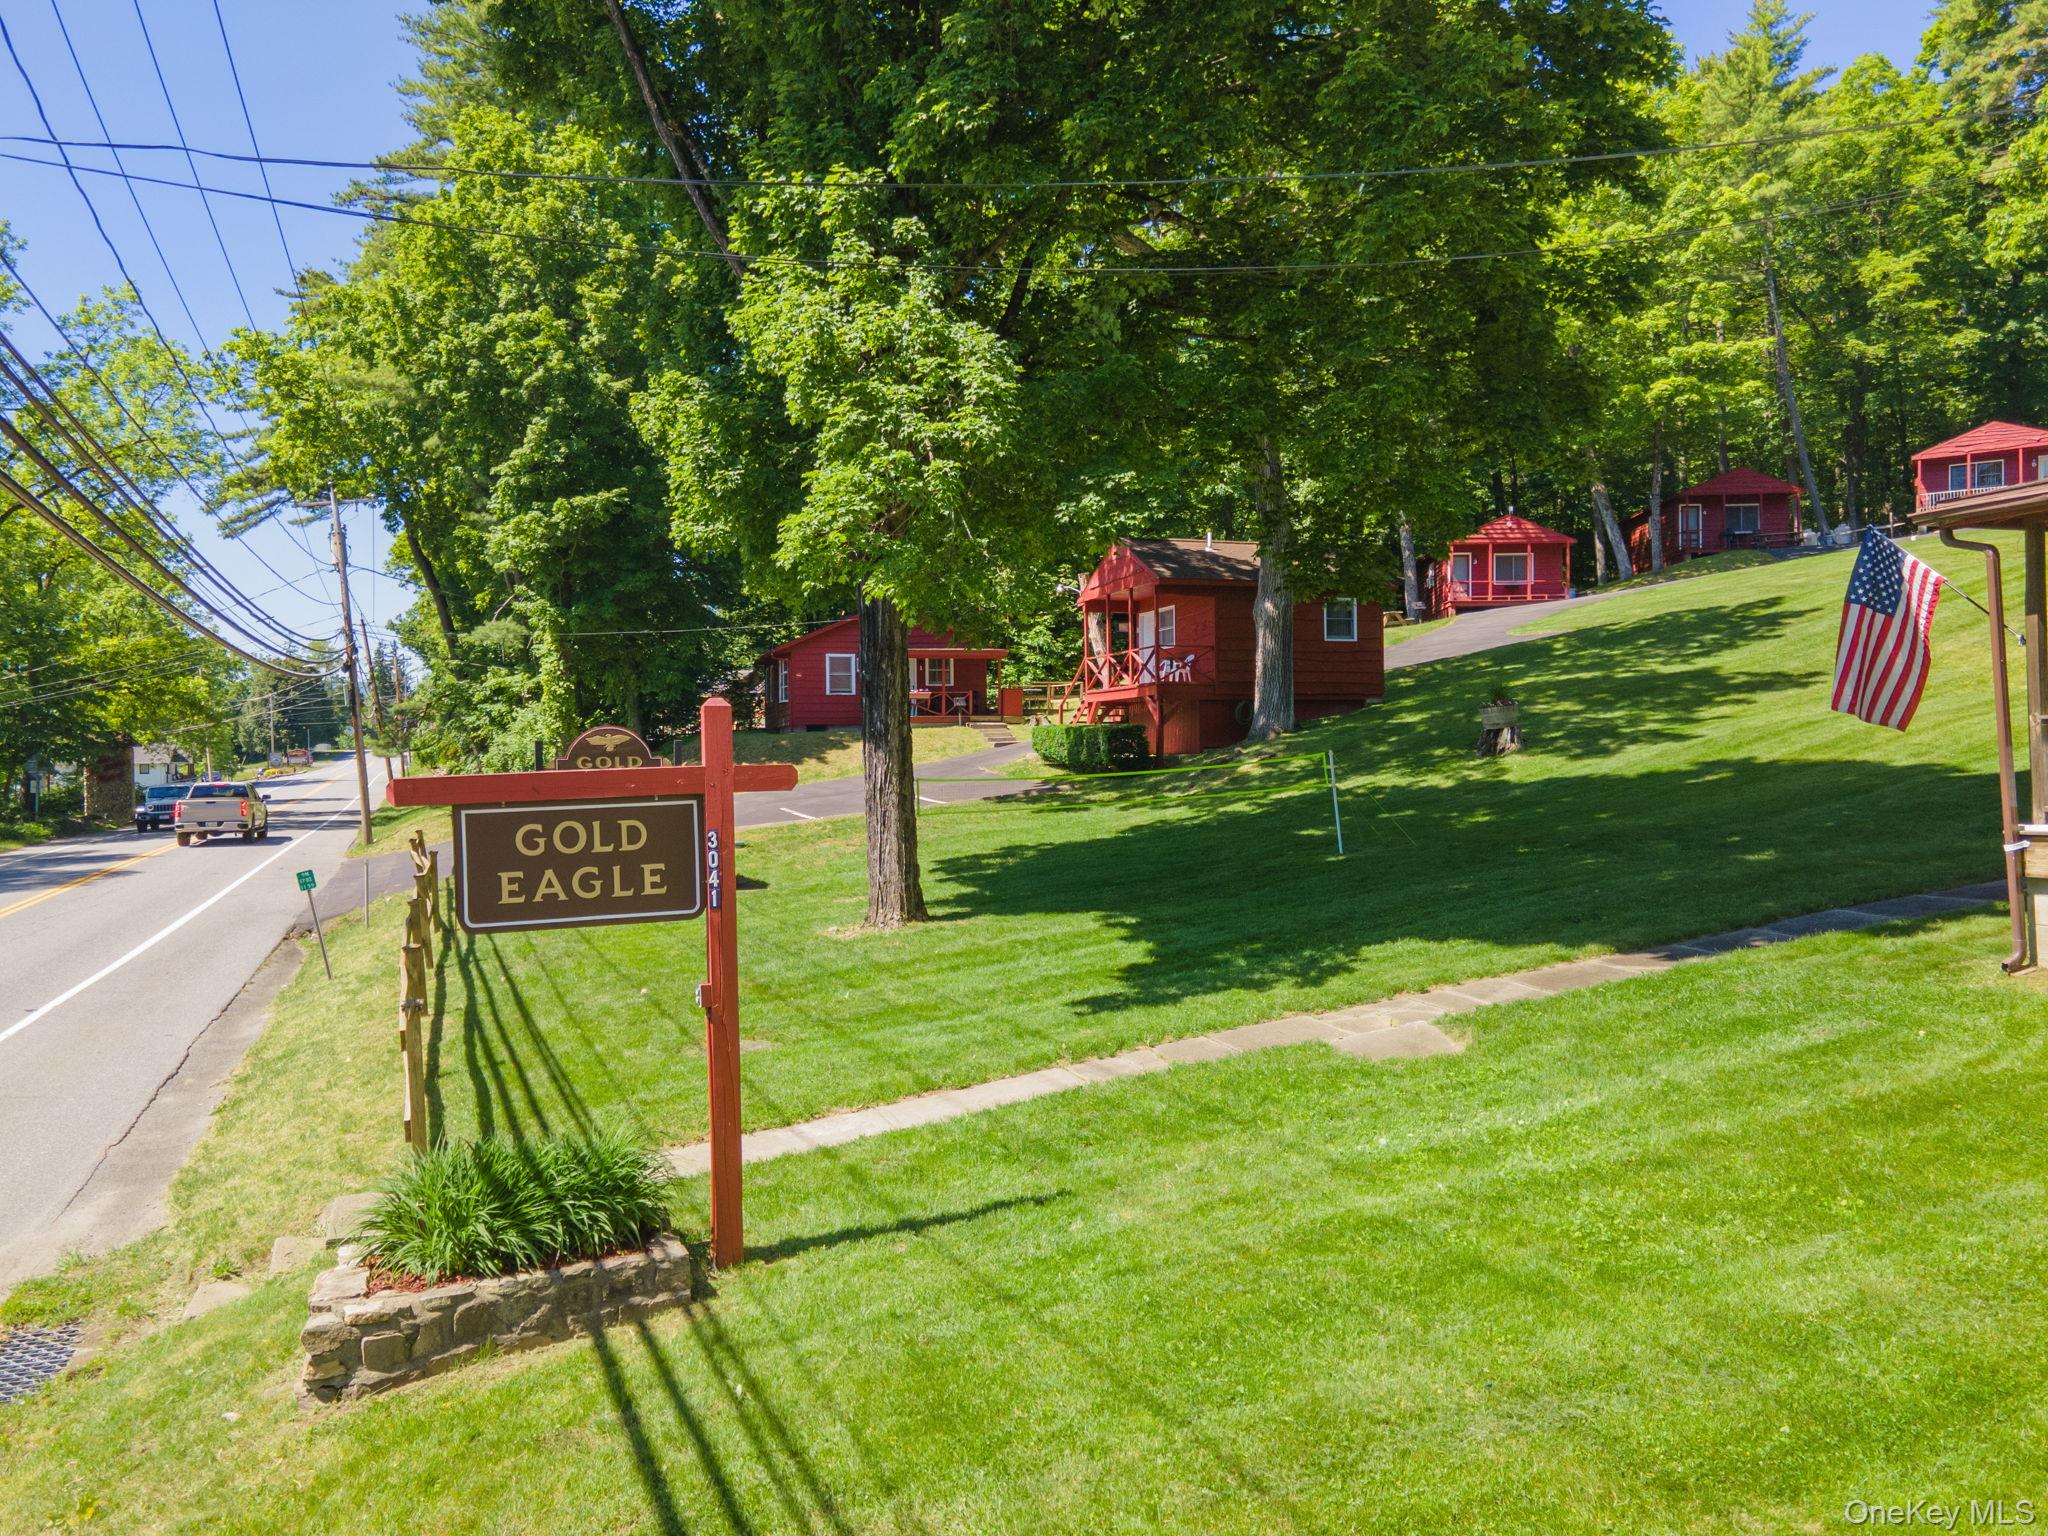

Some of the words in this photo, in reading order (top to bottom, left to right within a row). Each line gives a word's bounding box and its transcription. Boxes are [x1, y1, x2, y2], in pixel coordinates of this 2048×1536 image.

[576, 756, 643, 769] GOLD
[515, 819, 648, 857] GOLD
[498, 863, 668, 905] EAGLE
[707, 831, 719, 907] 3041
